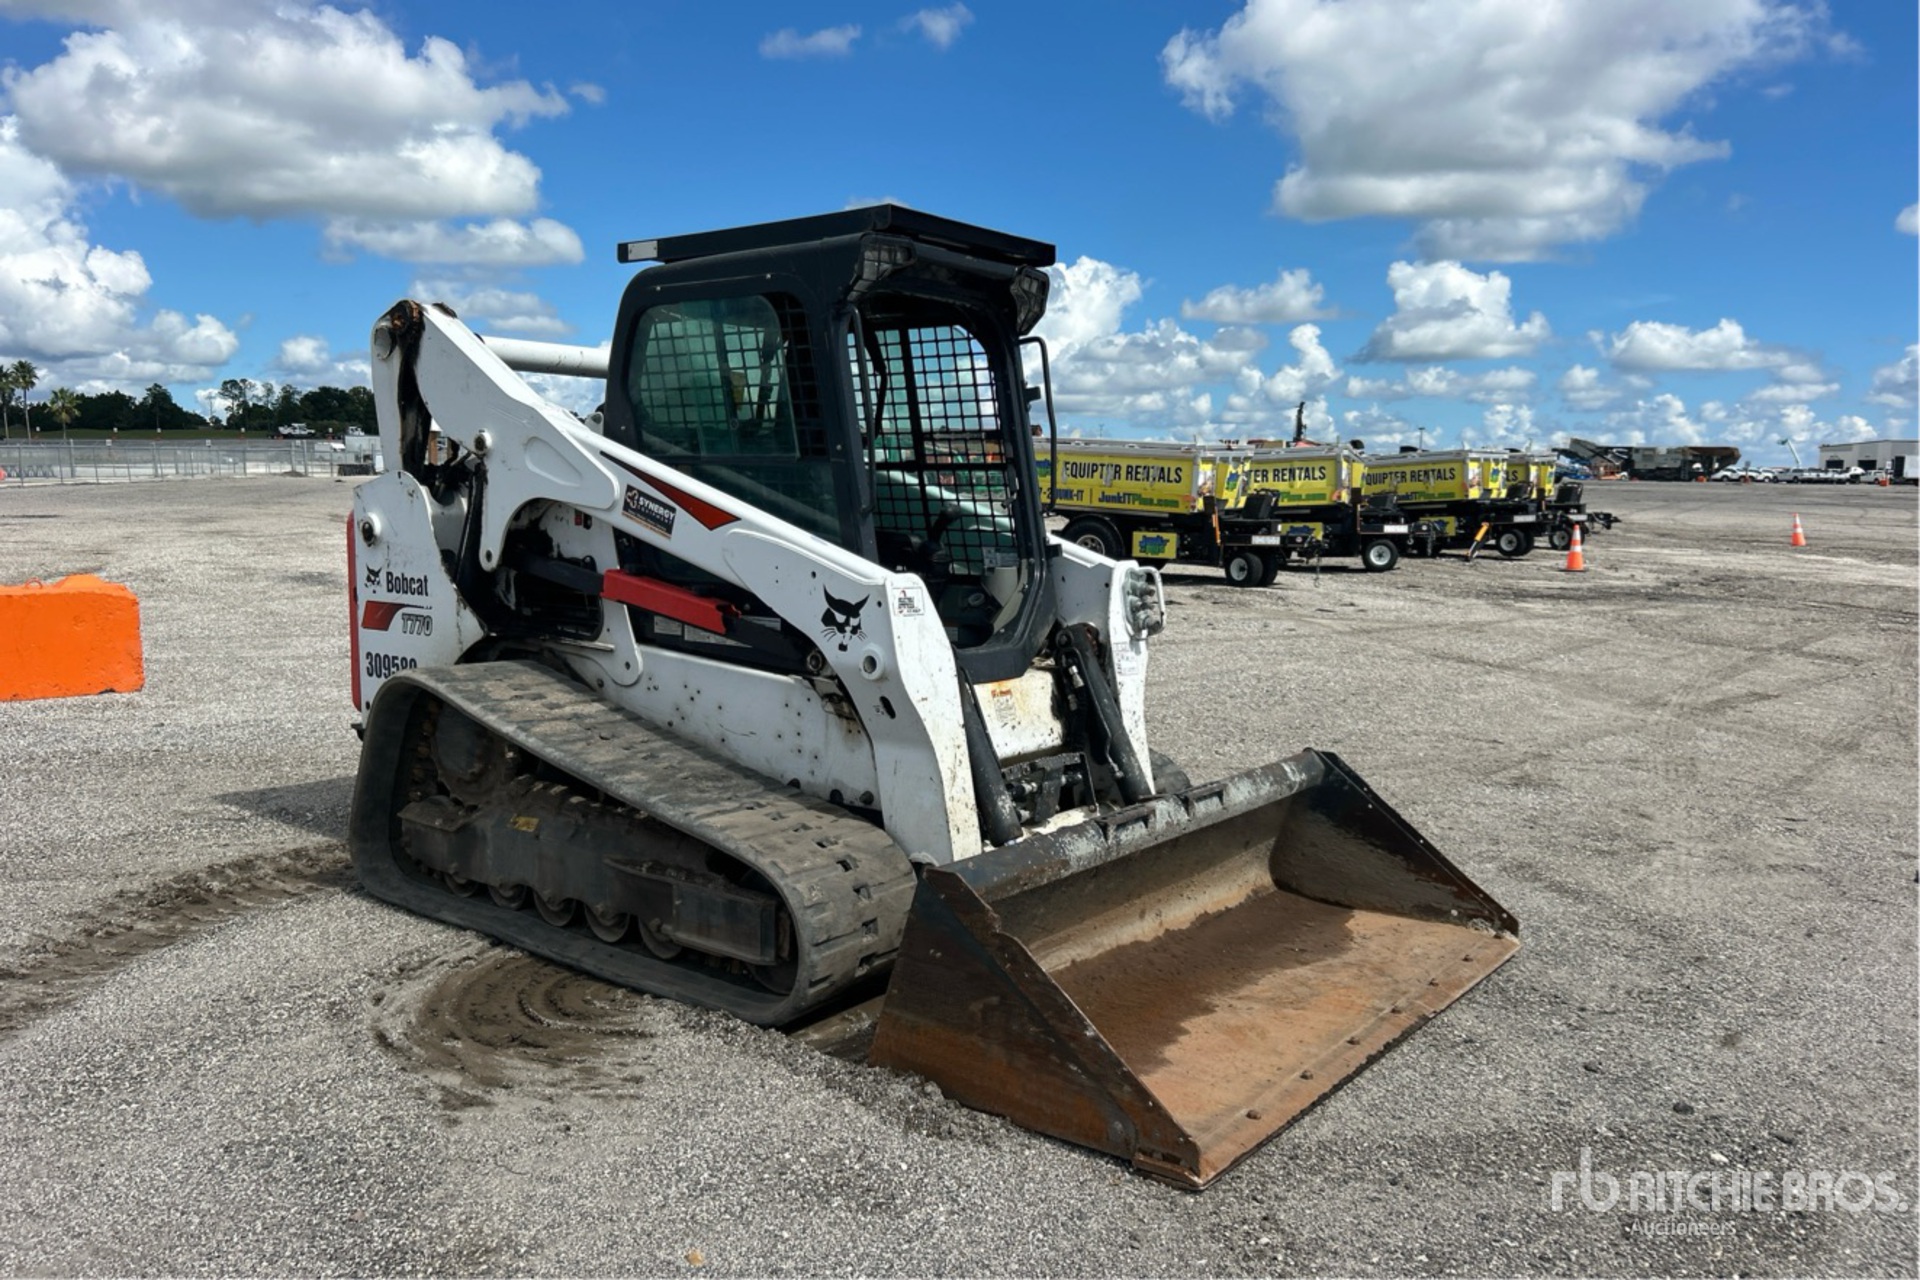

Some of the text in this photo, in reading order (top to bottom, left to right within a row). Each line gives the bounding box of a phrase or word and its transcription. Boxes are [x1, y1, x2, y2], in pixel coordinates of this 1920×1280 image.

[1273, 466, 1326, 482] RENTALS
[639, 496, 676, 520] SYNERGY
[386, 571, 429, 596] Bobcat
[401, 612, 433, 636] T770
